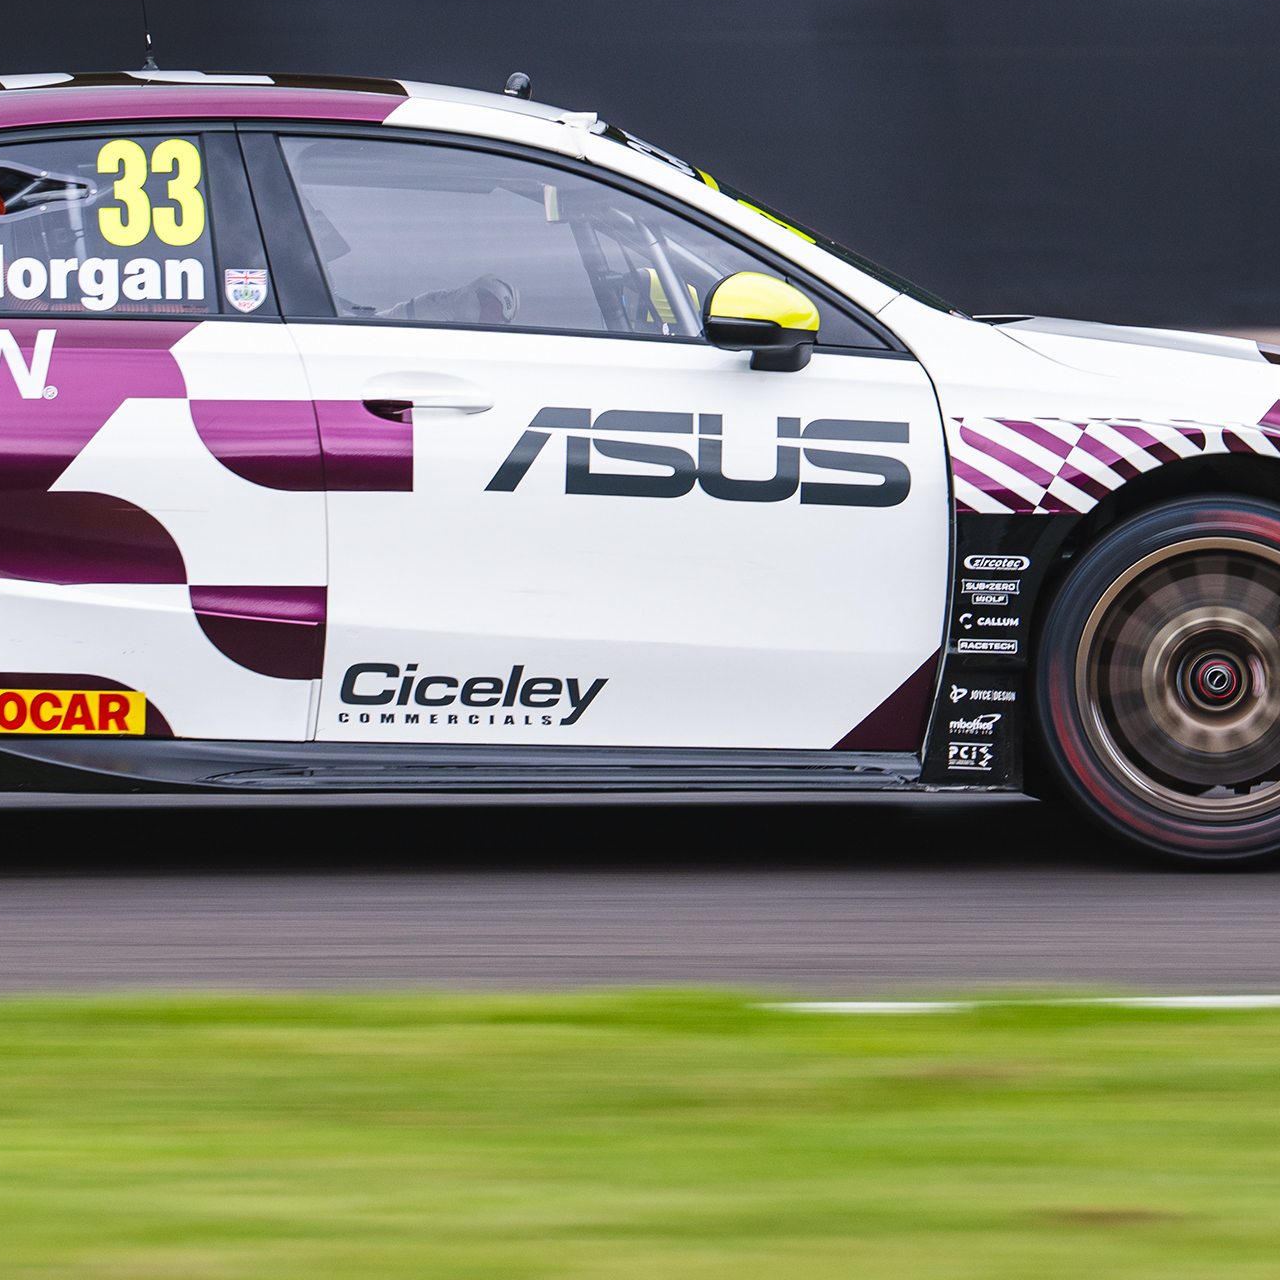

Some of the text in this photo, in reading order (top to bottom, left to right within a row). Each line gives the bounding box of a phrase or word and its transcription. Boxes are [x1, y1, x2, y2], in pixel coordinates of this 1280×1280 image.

[97, 139, 205, 246] 33
[483, 407, 911, 508] ASUS
[972, 557, 1022, 568] zircotec
[977, 617, 1020, 627] CALLUM
[960, 641, 1016, 650] RACETECH
[340, 662, 609, 726] Ciceley
[338, 712, 552, 726] COMMERCIALS
